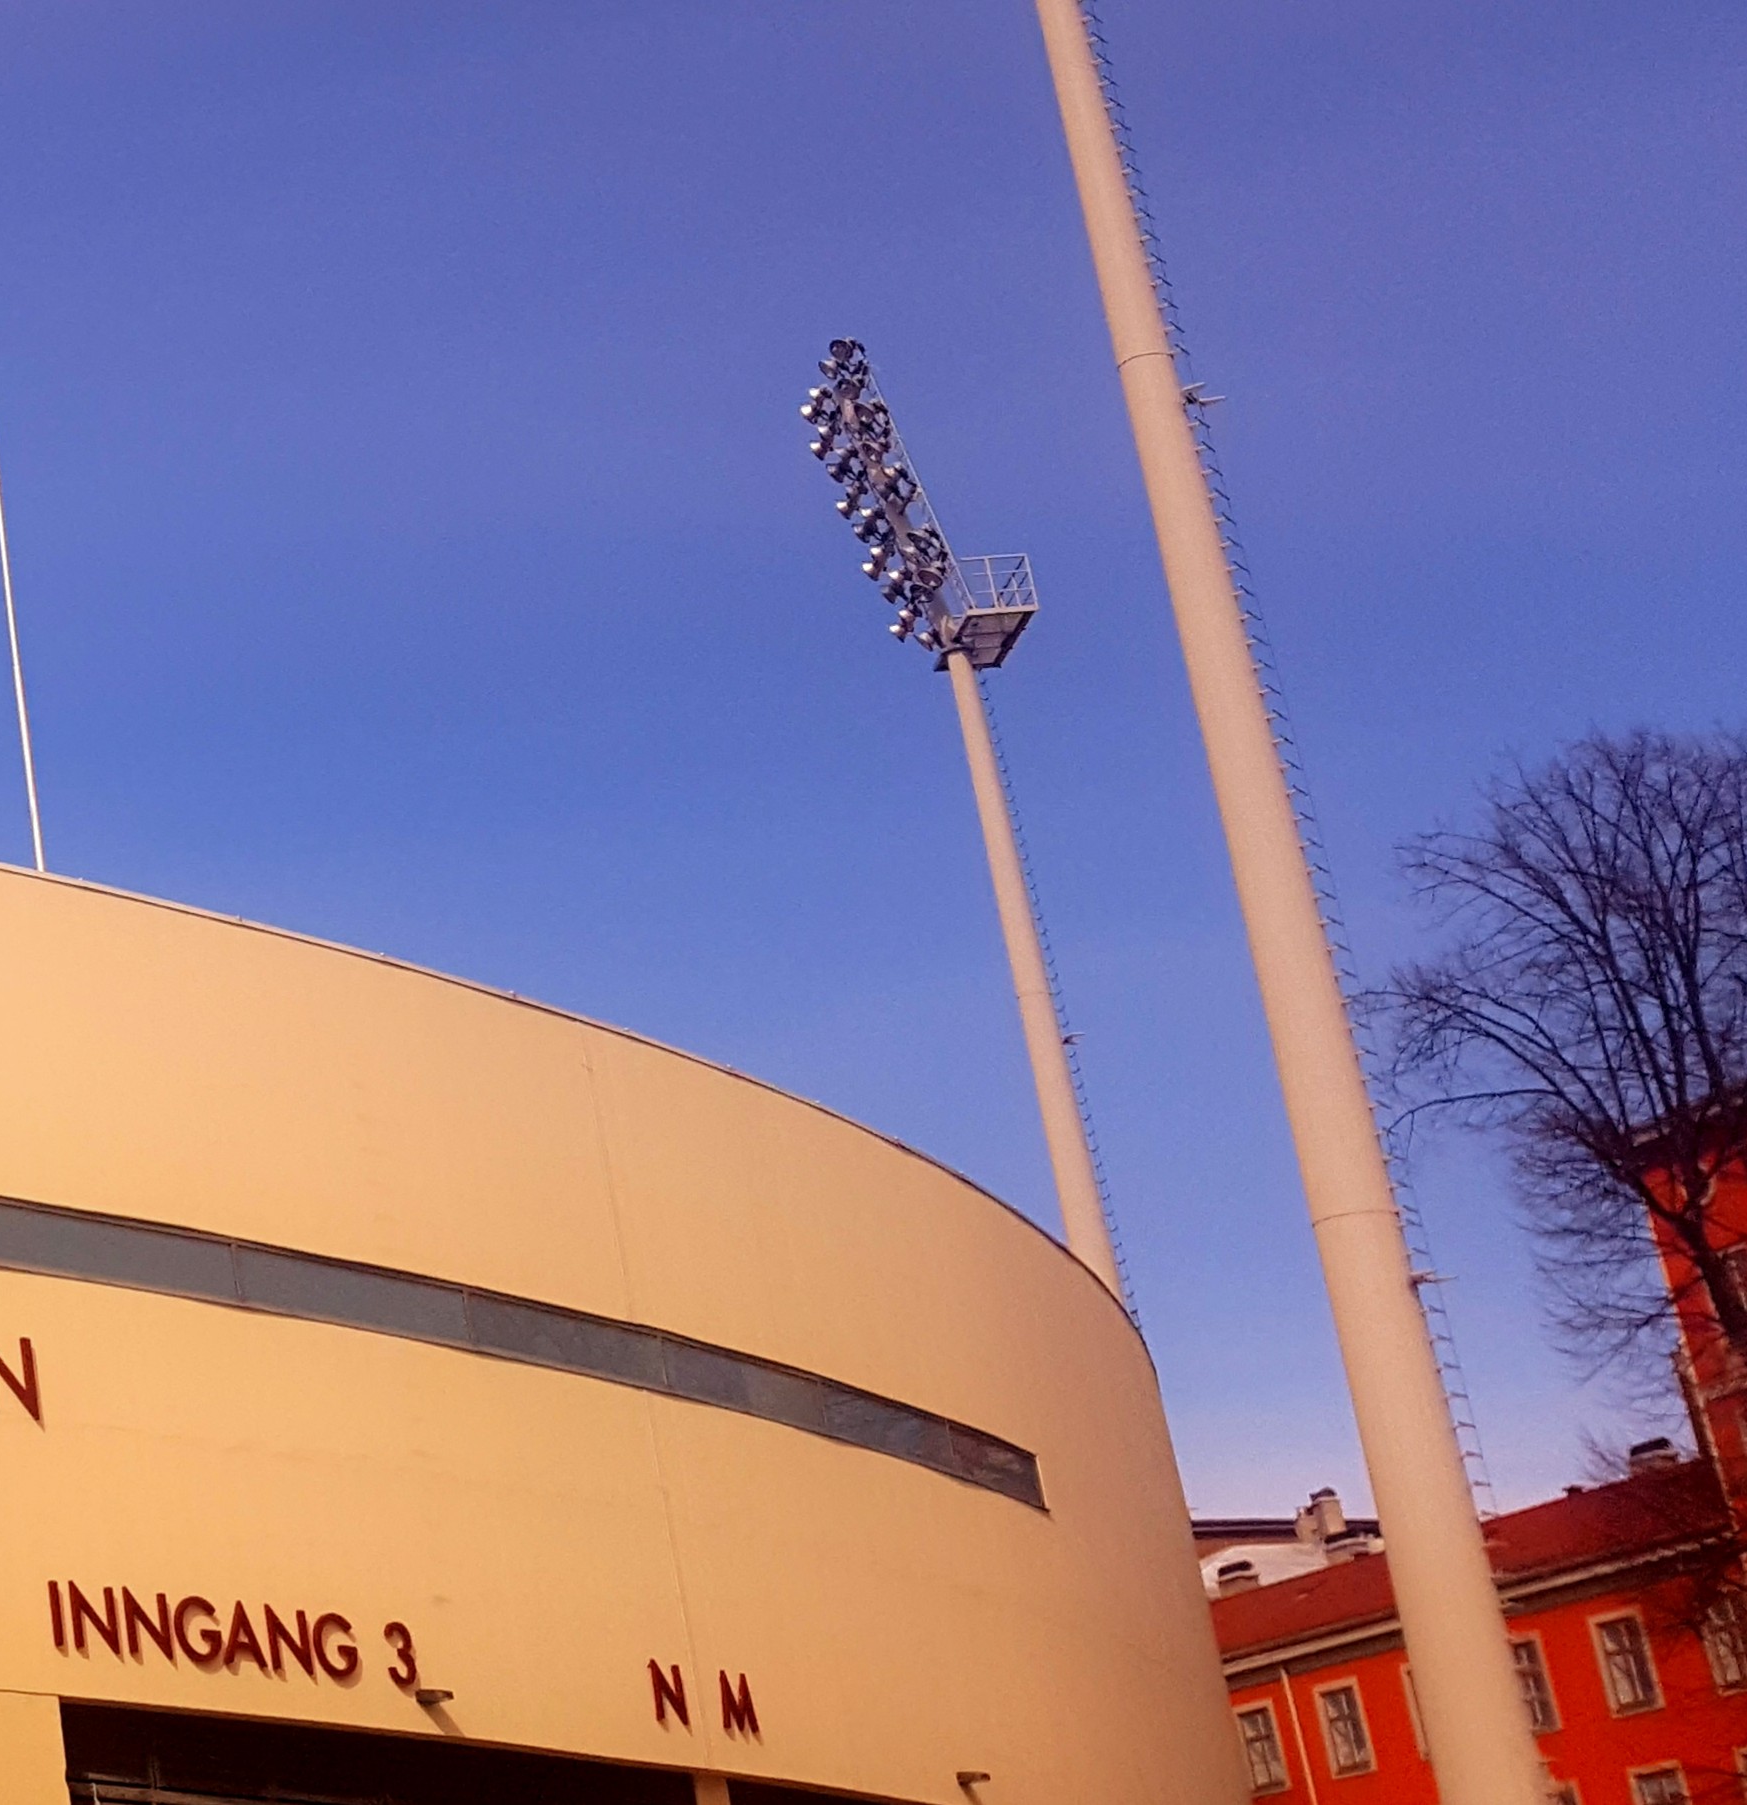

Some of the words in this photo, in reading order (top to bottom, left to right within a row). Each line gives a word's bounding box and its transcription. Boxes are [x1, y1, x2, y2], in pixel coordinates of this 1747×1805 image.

[47, 1579, 360, 1688] INNGANG
[383, 1620, 419, 1687] 3
[646, 1657, 692, 1731] N
[717, 1668, 762, 1743] M
